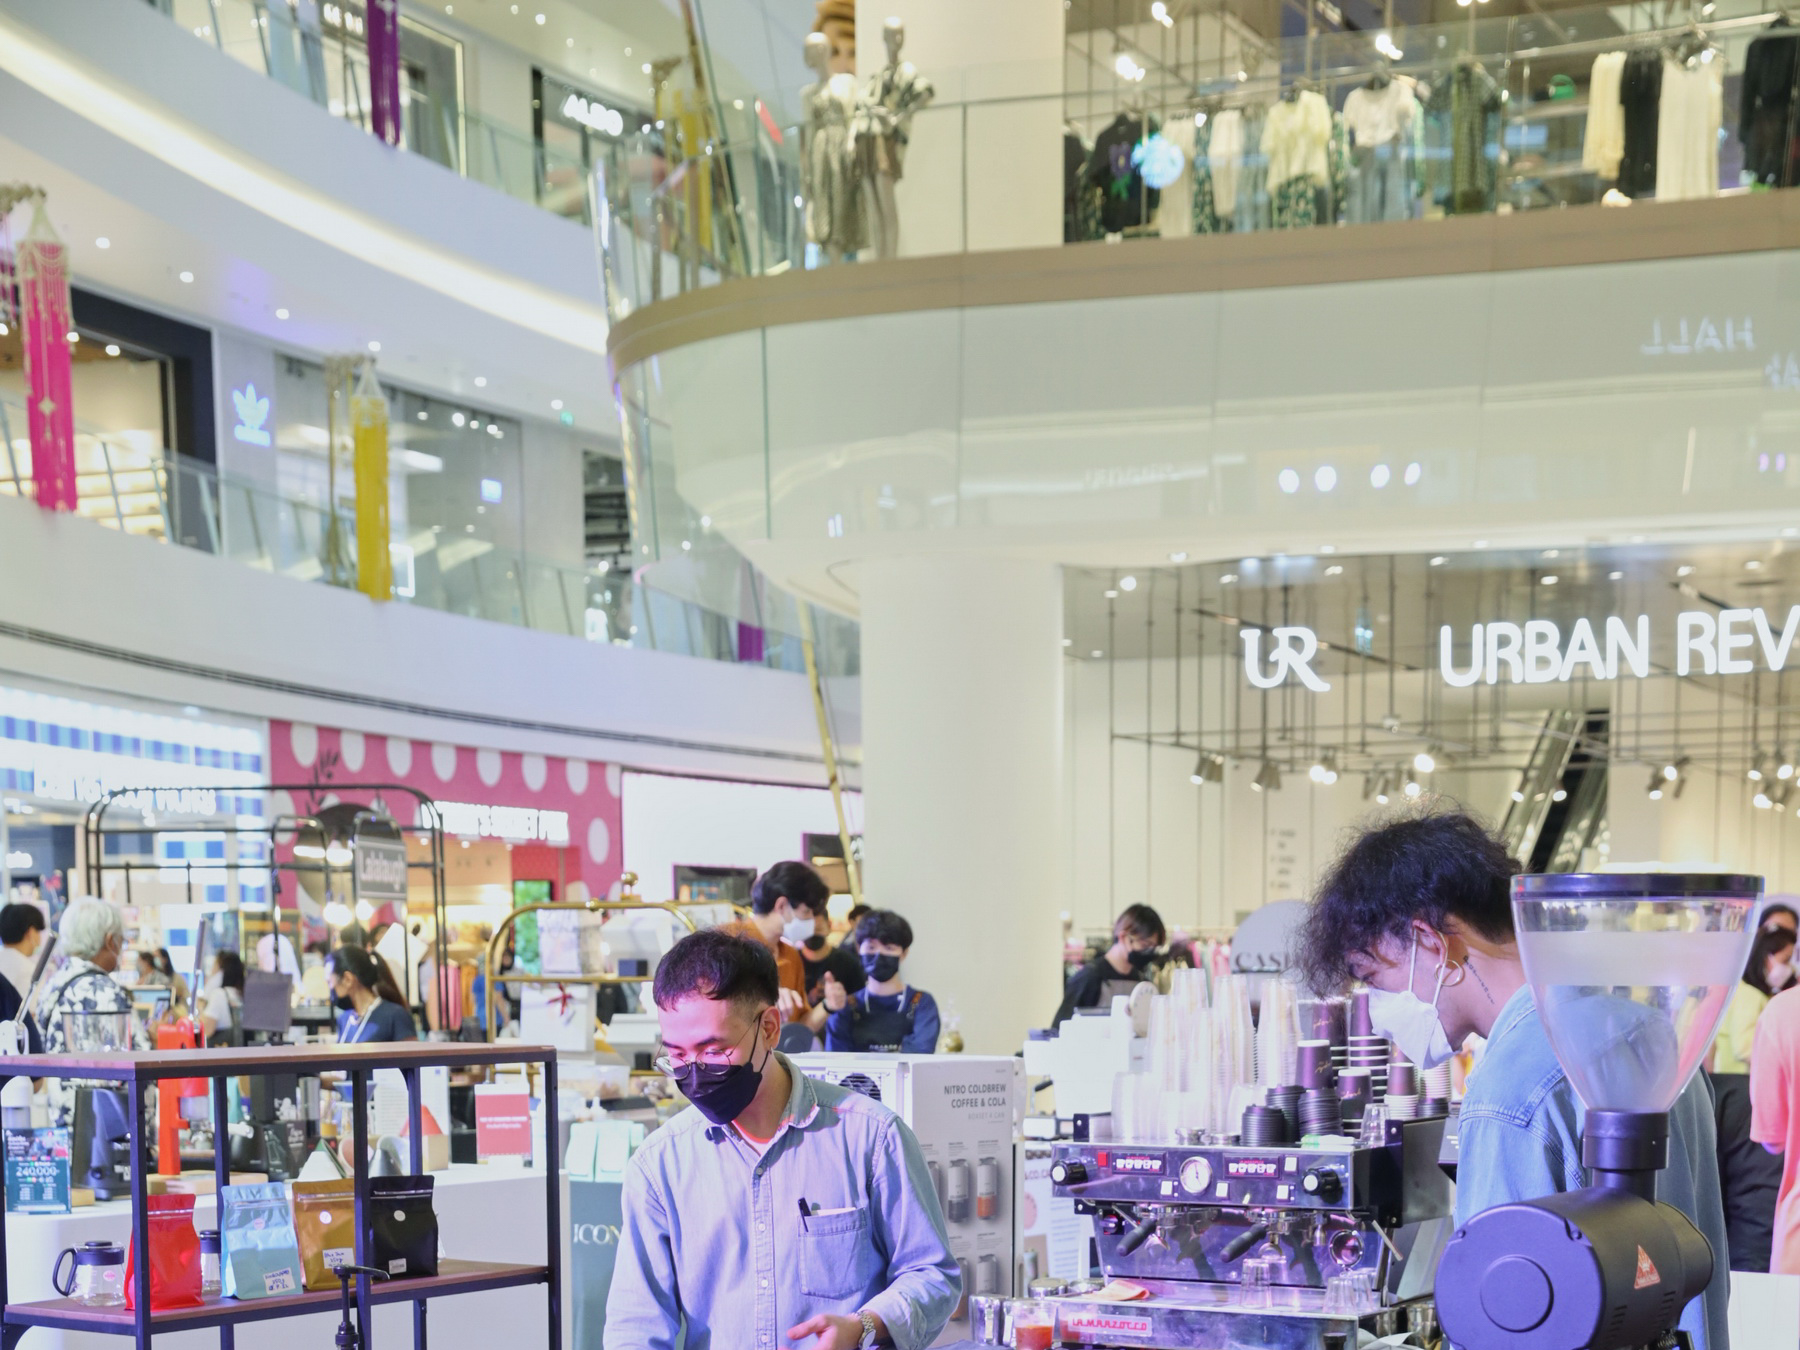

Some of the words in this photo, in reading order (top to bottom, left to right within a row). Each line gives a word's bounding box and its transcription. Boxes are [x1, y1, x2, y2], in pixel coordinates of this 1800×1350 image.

[1240, 626, 1331, 692] UR
[1440, 617, 1649, 688] URBAN
[1677, 604, 1800, 676] REV
[944, 1085, 966, 1095] NITRO
[968, 1083, 1006, 1094] COLDBREW
[951, 1098, 978, 1108] COFFEE
[987, 1097, 1006, 1107] COLA
